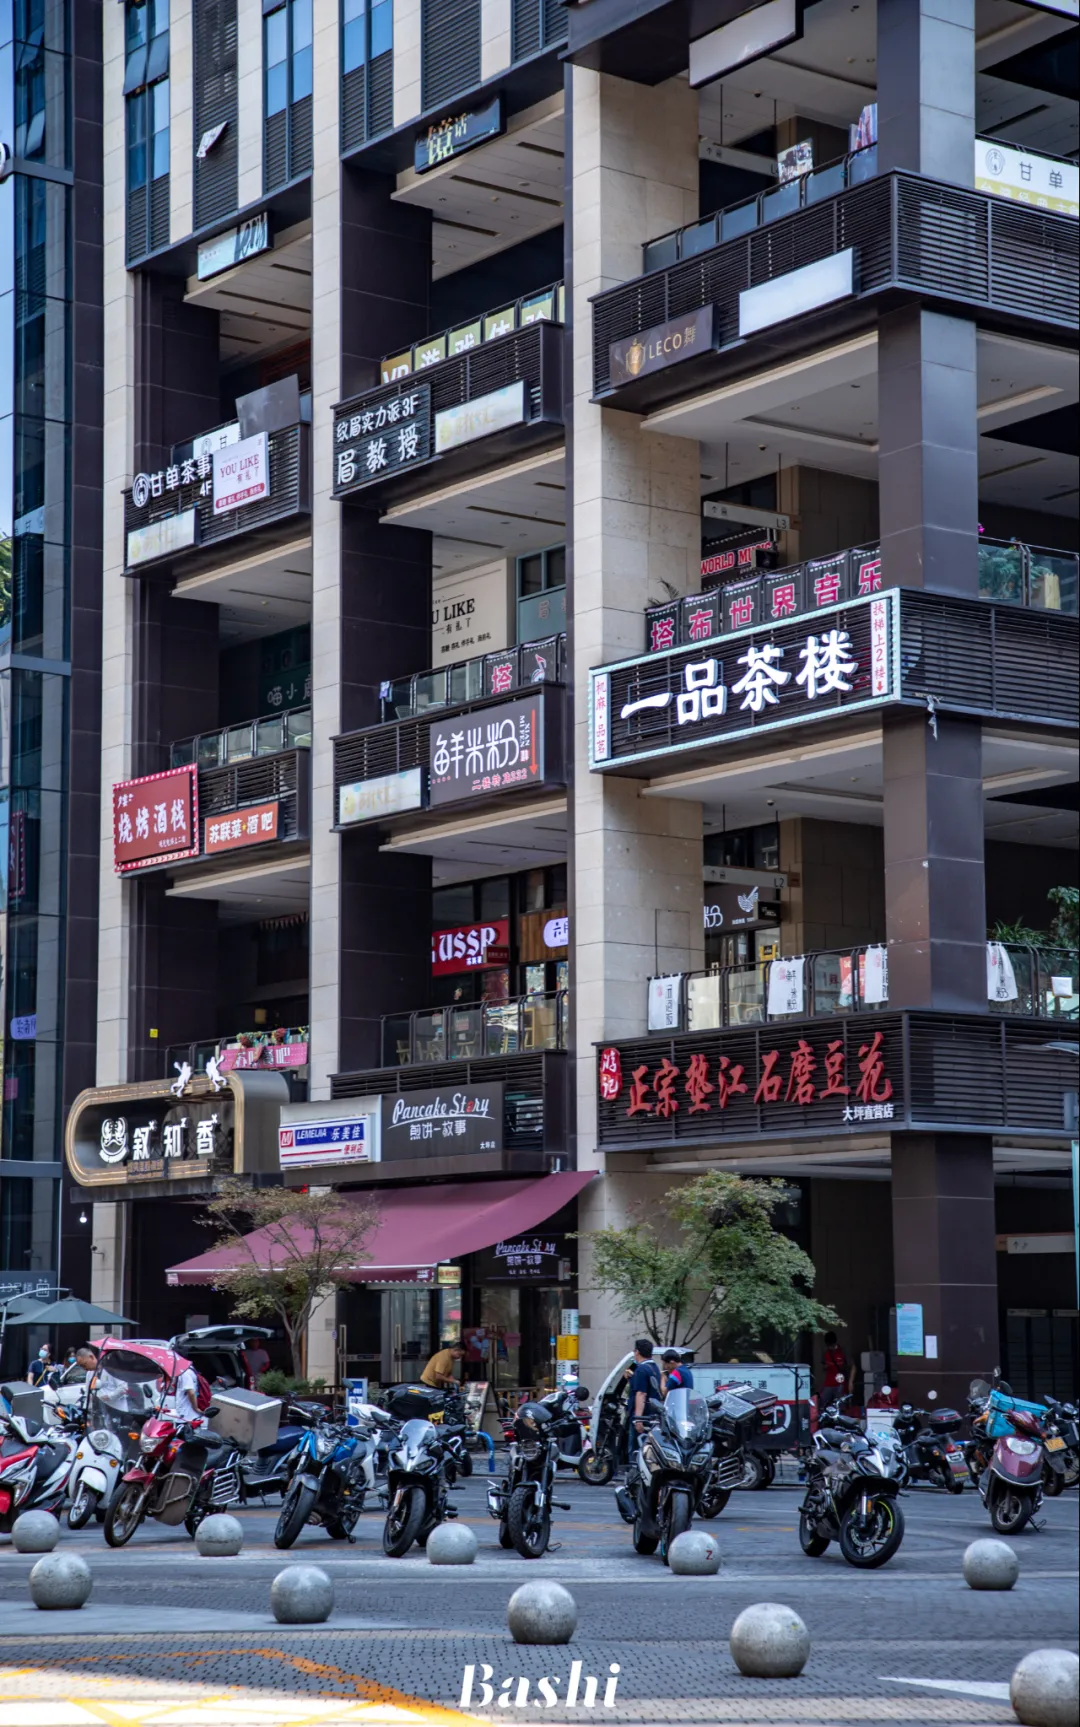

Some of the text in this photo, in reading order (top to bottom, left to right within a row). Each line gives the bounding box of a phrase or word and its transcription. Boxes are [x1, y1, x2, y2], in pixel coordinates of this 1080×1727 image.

[220, 453, 260, 478] YOU LIKE
[336, 423, 420, 486] 眉教授
[150, 453, 212, 498] 甘单茶事
[776, 518, 787, 530] L3
[443, 597, 475, 621] LIKE
[621, 629, 858, 725] 一品茶楼
[434, 718, 520, 779] 鲜米粉
[118, 798, 187, 844] 烧烤酒栈
[626, 1032, 893, 1117] 正宗垫江石磨豆花
[392, 1092, 490, 1124] Pancake Story
[842, 1103, 894, 1120] 大坪直营店
[331, 1125, 361, 1140] 乐美佳
[344, 1143, 364, 1155] 便利店
